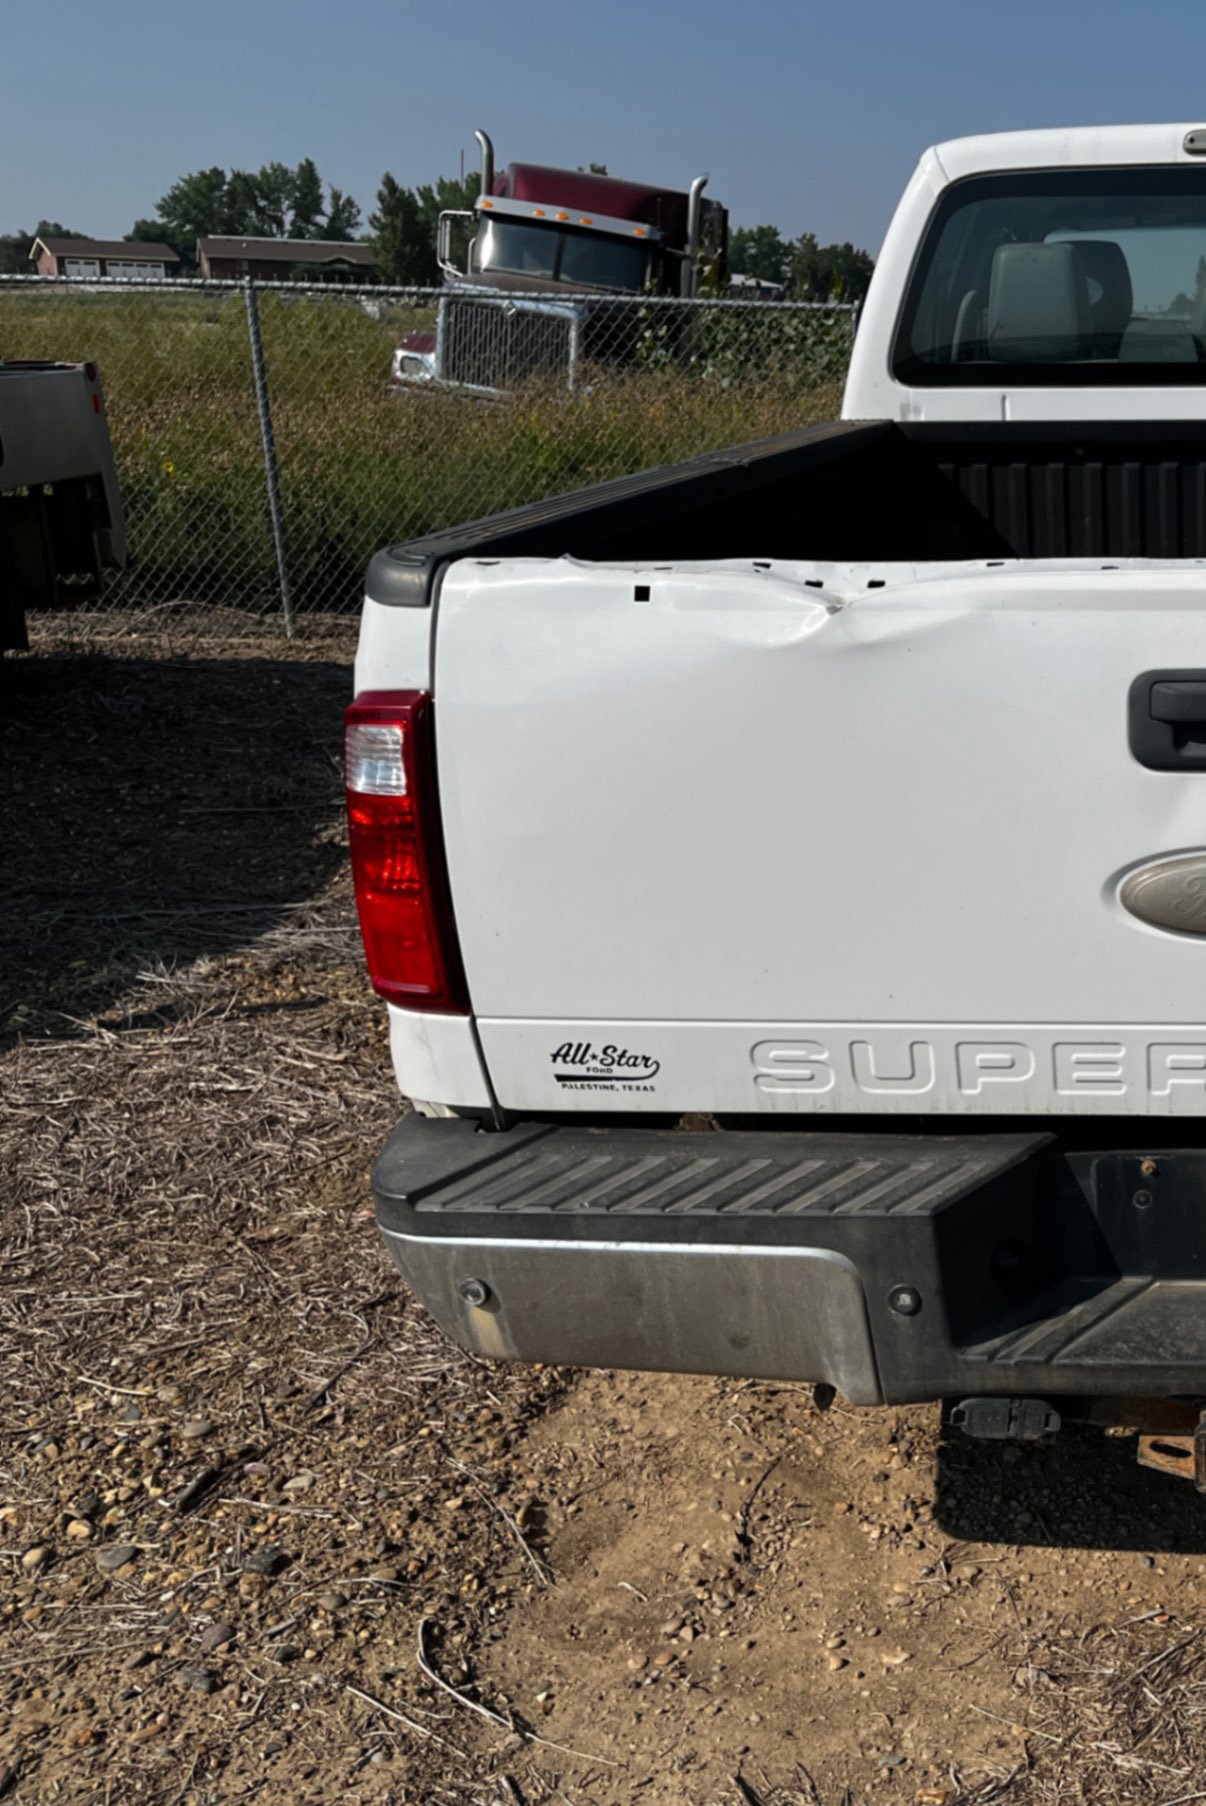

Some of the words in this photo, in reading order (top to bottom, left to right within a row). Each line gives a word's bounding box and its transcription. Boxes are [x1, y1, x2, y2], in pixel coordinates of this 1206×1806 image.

[586, 1066, 613, 1074] FORD
[561, 1083, 619, 1092] PALESTINE,
[622, 1084, 656, 1092] TEXAS
